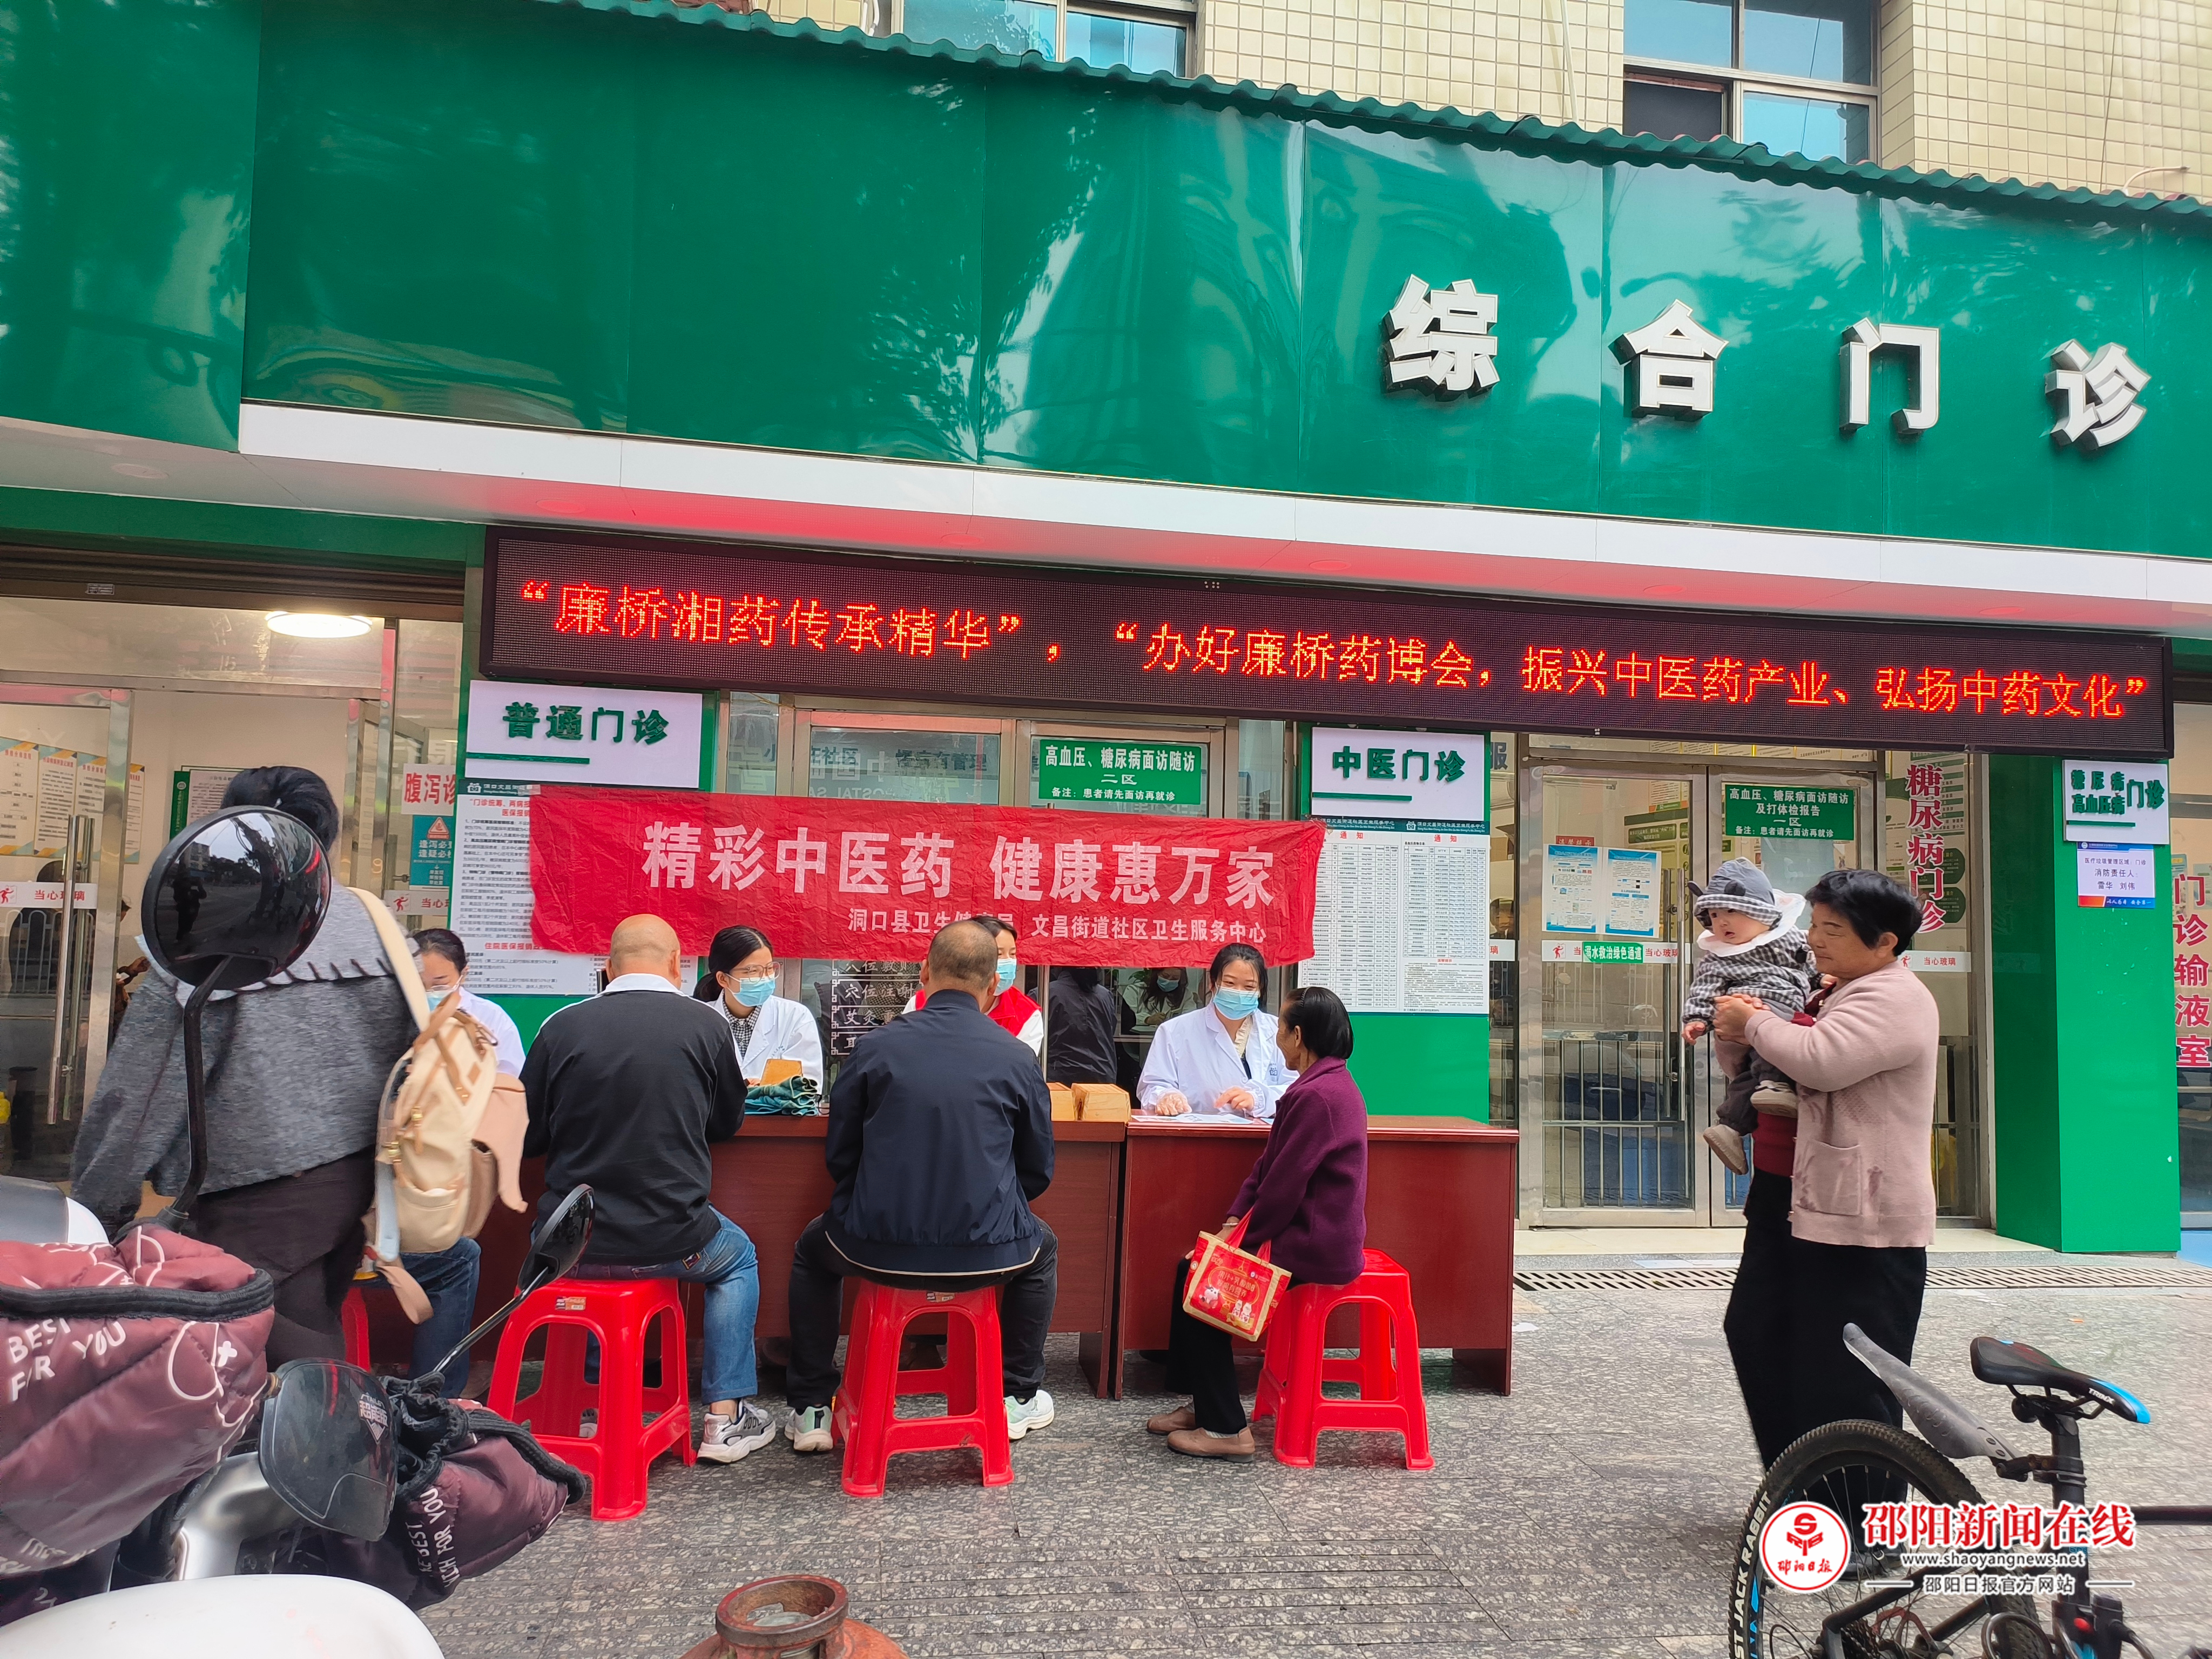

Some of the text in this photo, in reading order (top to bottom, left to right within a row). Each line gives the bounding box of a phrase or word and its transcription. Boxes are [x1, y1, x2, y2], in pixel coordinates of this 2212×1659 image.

[1386, 273, 2153, 447] 综合门诊
[502, 702, 670, 745] 普通门诊
[1045, 745, 1195, 772] 高血压、糖尿病面访随访
[1332, 745, 1467, 783] 中医门诊
[404, 772, 456, 805] 腹泻诊
[1101, 774, 1137, 786] 二区
[2071, 770, 2125, 791] 糖尿病
[1729, 788, 1849, 805] 高血压、糖尿病面访随访
[2072, 793, 2125, 815] 高血压病
[2127, 779, 2165, 810] 门诊
[1756, 803, 1820, 817] 及打体检报告
[1773, 817, 1802, 827] 一区
[1340, 831, 1364, 839] 通知
[1434, 834, 1457, 842] 通知
[1906, 764, 1945, 932] 糖尿病门诊
[642, 821, 1275, 909] 精彩中医药 健康惠万家
[34, 889, 86, 902] 当心璃
[848, 907, 1267, 944] 洞口县卫生 文昌街道社区卫生服务中心
[1584, 945, 1642, 960] 溺水救治绿色通道
[1923, 956, 1957, 966] 当心玻璃
[2173, 874, 2211, 1068] 门诊输液室
[845, 983, 915, 999] 穴位注射
[11, 1355, 55, 1401] FR
[2088, 1387, 2115, 1405] TRINX
[420, 1488, 447, 1525] YOU
[1734, 1491, 1771, 1659] ST JACK RABBIT
